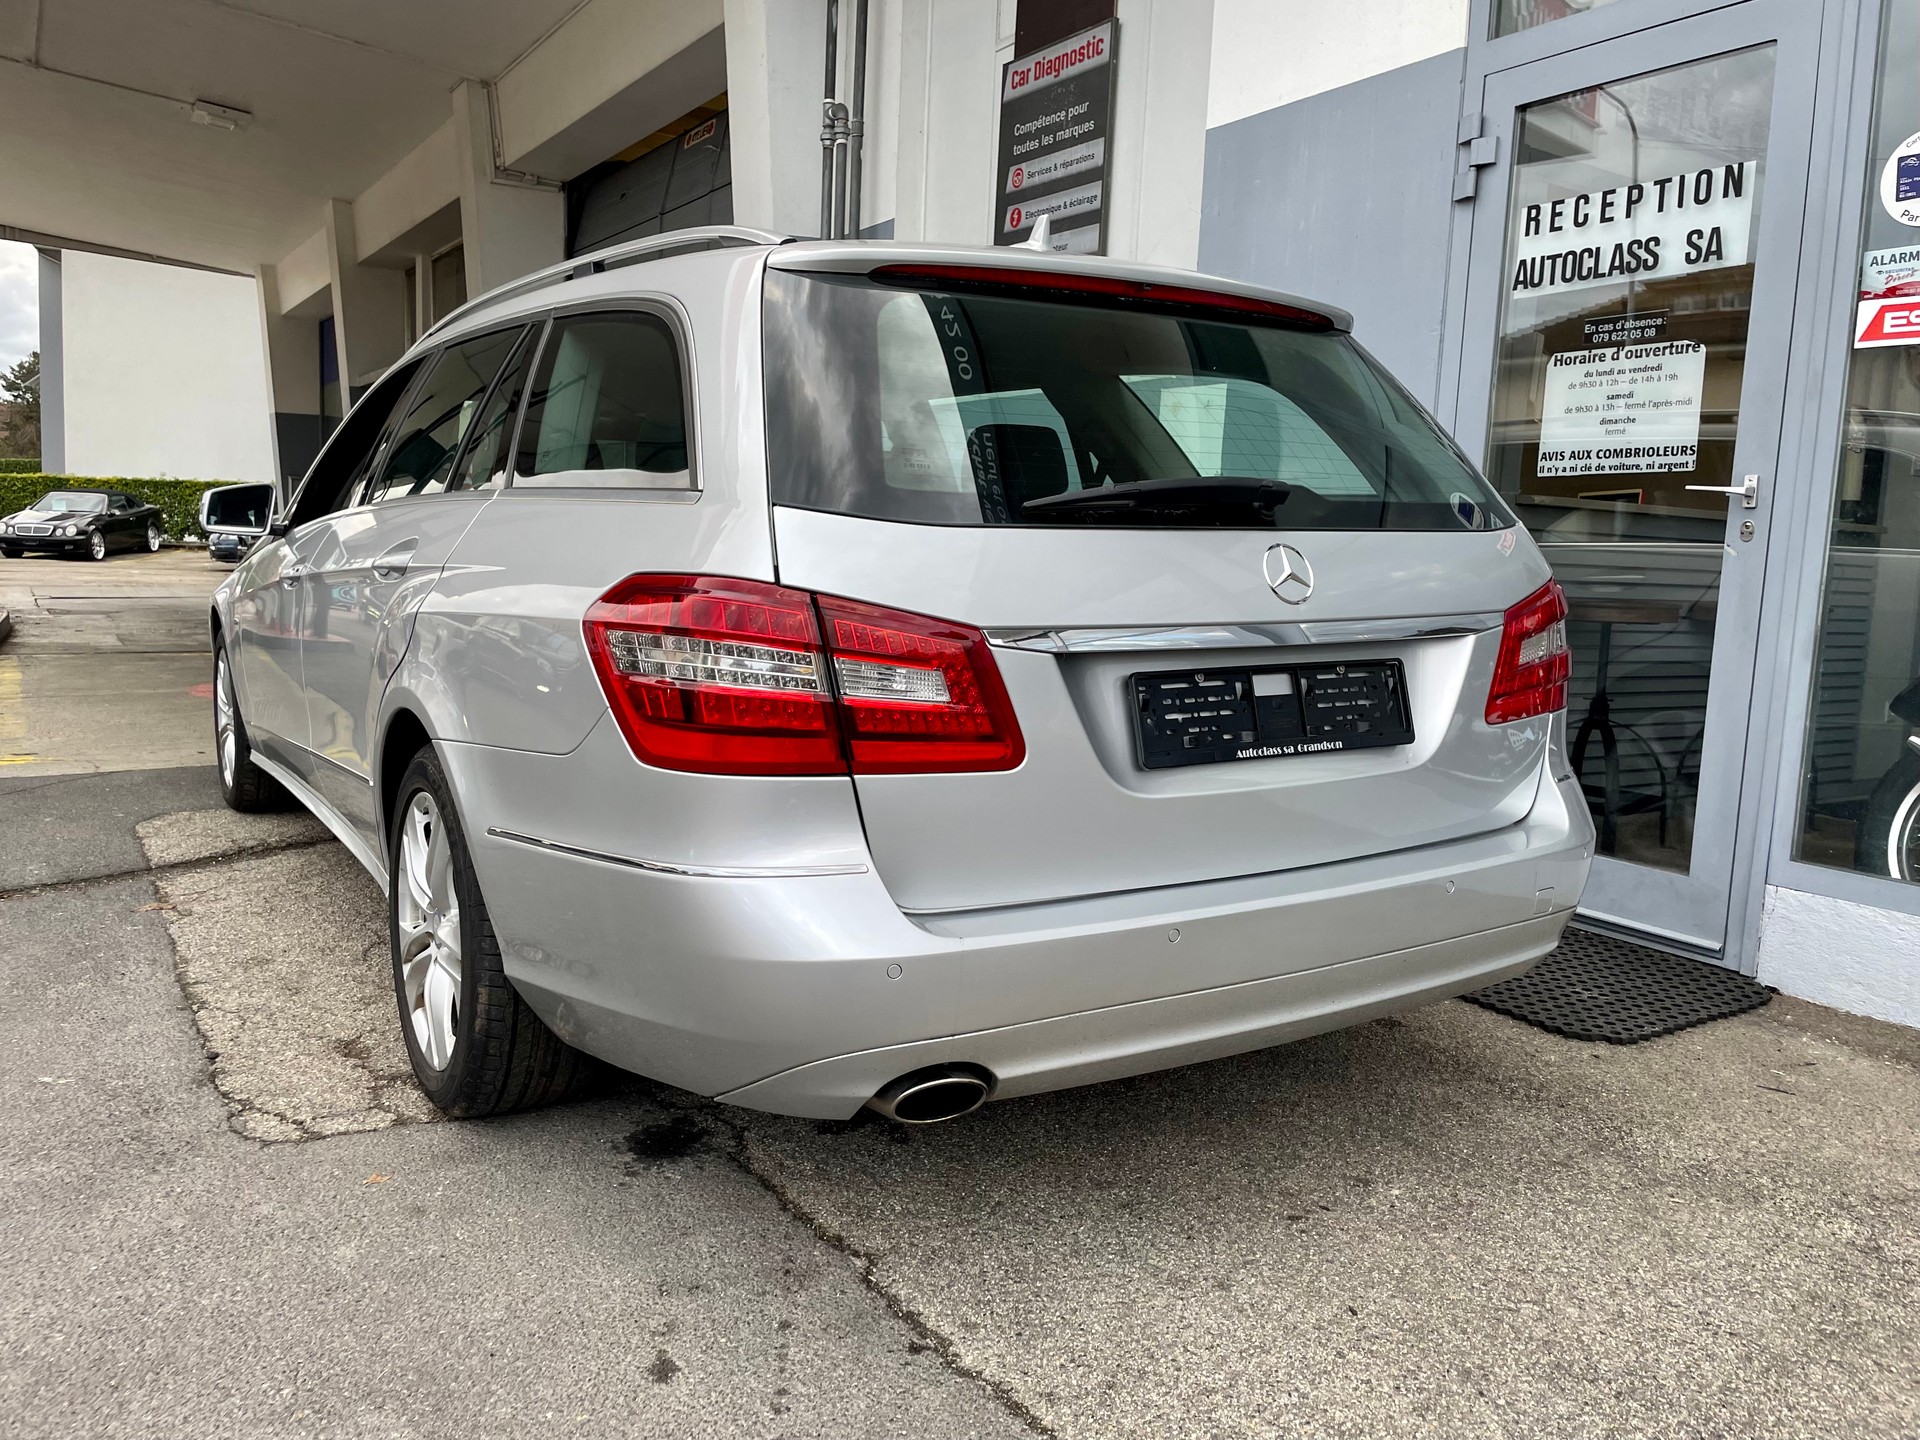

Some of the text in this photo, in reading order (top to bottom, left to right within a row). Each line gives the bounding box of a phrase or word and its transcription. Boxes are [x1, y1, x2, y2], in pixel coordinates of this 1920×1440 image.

[1011, 35, 1104, 90] Car Diagnostic
[1014, 101, 1089, 136] Compétence pour
[1013, 120, 1095, 155] toutes les marques
[1027, 152, 1095, 179] Services & réparations
[1025, 194, 1098, 219] Electronique & éclairage
[1524, 161, 1744, 237] RECEPTION
[1512, 226, 1723, 291] AUTOCLASS SA
[1584, 324, 1596, 333] En
[1598, 323, 1613, 331] cas
[1593, 328, 1656, 343] 079 622 05 08
[1554, 350, 1606, 367] Horaire
[1584, 370, 1593, 378] du
[1596, 368, 1615, 377] lundi
[1629, 363, 1662, 374] vendredi
[1568, 382, 1577, 390] de
[1579, 380, 1597, 389] 9h30
[1606, 378, 1618, 386] 12h
[1629, 377, 1638, 385] de
[1641, 375, 1654, 383] 14h
[1665, 373, 1678, 382] 19h
[1606, 391, 1634, 400] samedi
[1564, 406, 1573, 414] de
[1575, 404, 1593, 413] 9h30
[1602, 403, 1614, 411] 13h
[1624, 401, 1646, 410] fermé
[1599, 416, 1636, 425] dimanche
[1605, 427, 1626, 435] fermé
[1540, 445, 1696, 462] AVIS AUX COMBRIOLEURS
[1539, 465, 1545, 473] Il
[1569, 464, 1578, 472] ni
[1580, 463, 1592, 472] clé
[1595, 463, 1606, 472] de
[1608, 462, 1643, 471] voiture,
[1646, 461, 1655, 470] ni
[1658, 460, 1689, 472] argent
[1235, 740, 1343, 759] Autoclass sa Grandson
